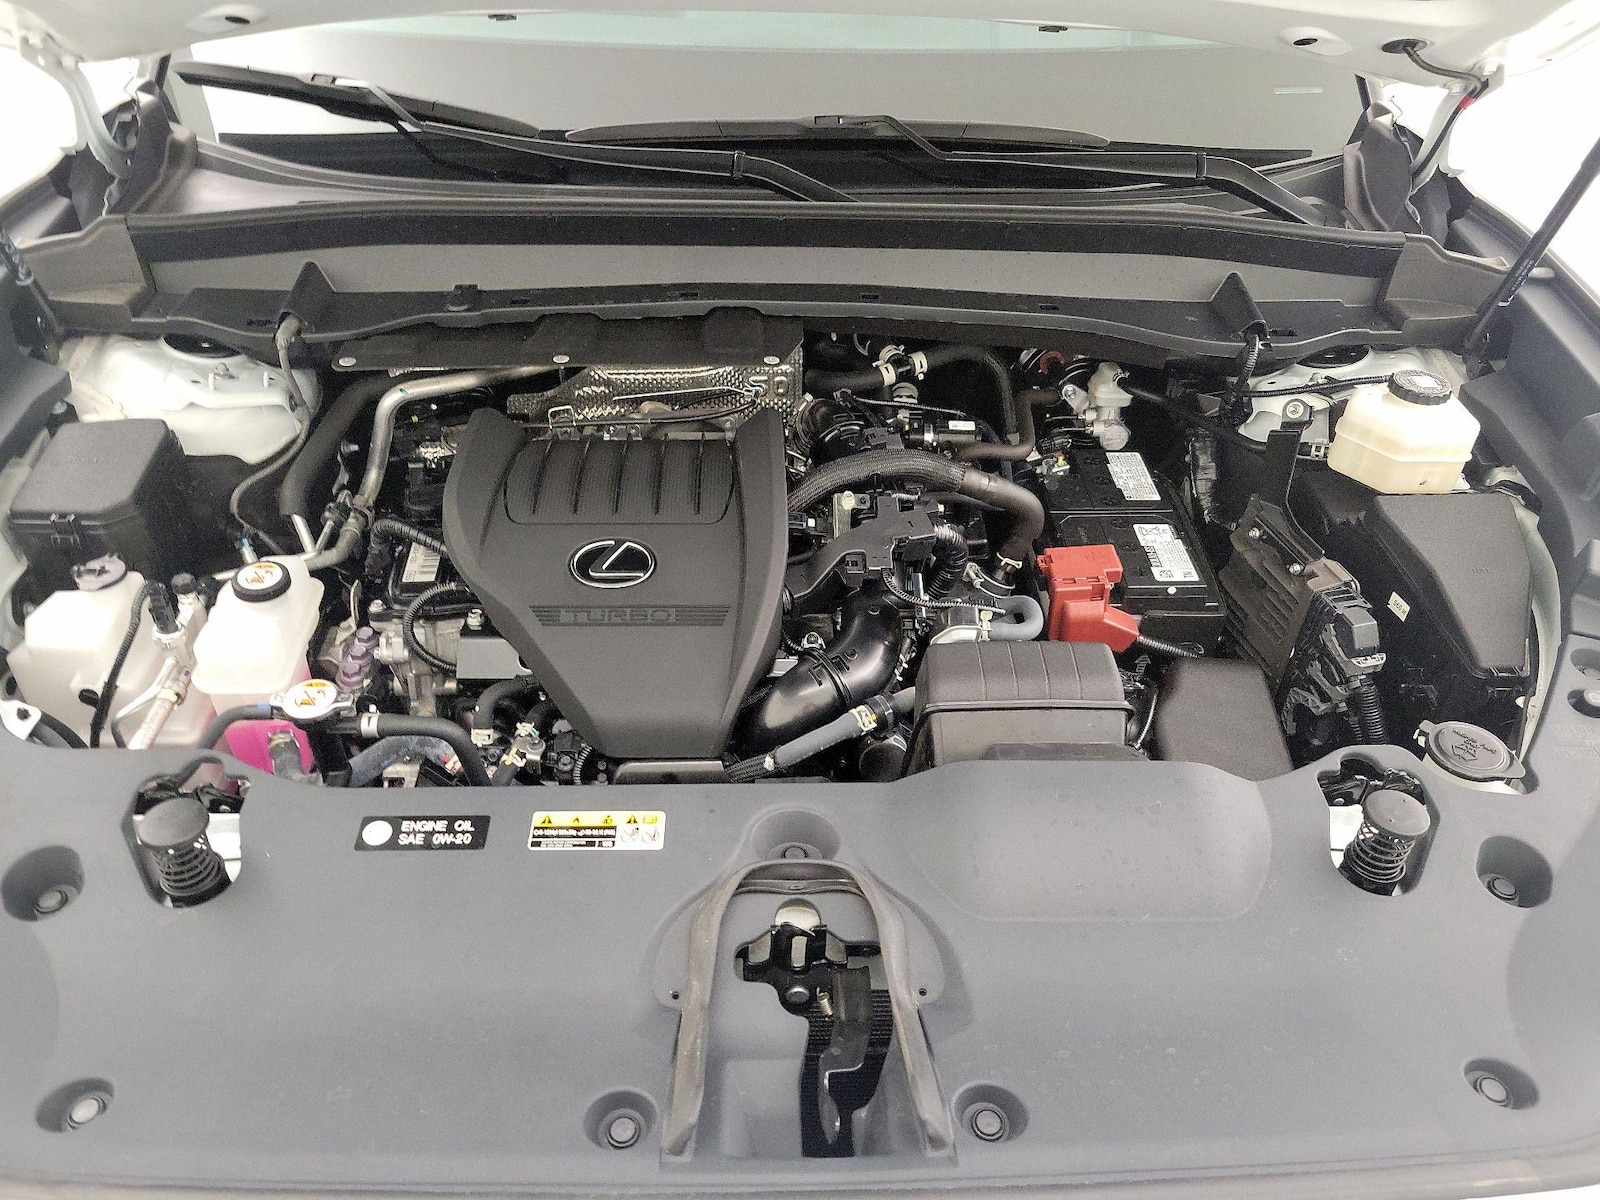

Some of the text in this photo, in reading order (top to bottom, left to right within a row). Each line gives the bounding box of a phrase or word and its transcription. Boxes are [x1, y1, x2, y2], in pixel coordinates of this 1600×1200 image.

[563, 608, 672, 622] TURBO
[401, 820, 475, 832] ENGINE OIL
[398, 833, 425, 845] SAE
